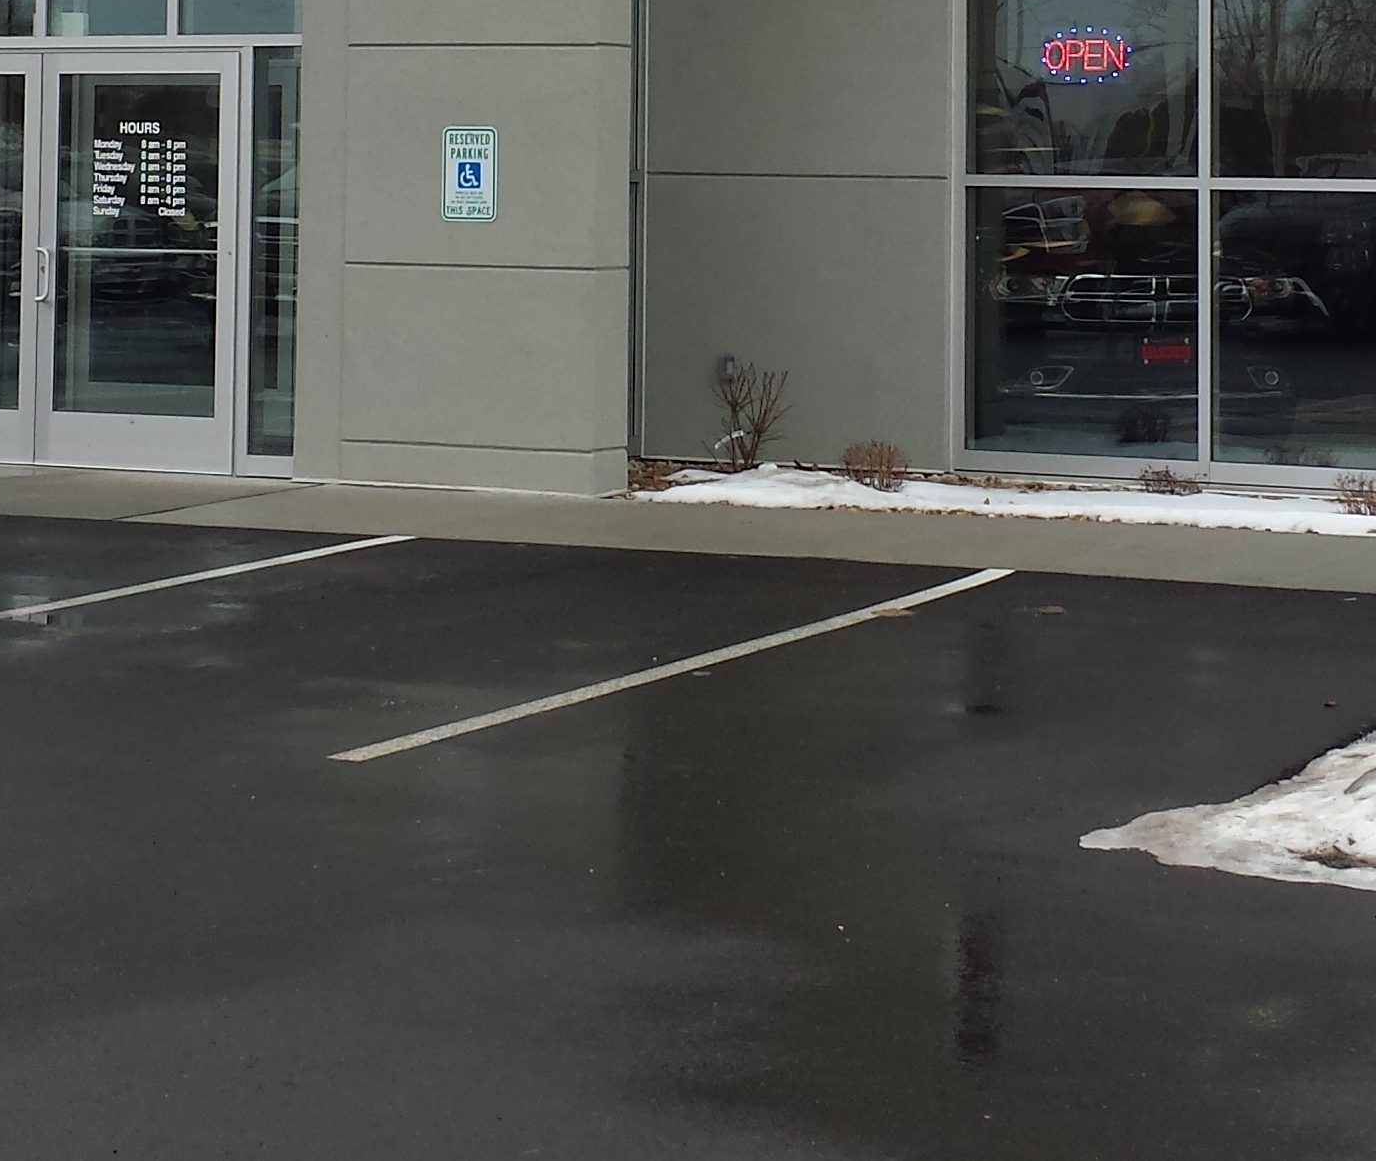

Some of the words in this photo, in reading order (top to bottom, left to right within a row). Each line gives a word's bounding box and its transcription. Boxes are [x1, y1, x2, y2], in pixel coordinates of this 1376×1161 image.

[1045, 39, 1124, 71] OPEN
[119, 122, 161, 134] HOURS
[94, 139, 122, 151] Monday
[174, 141, 186, 151] pm
[449, 134, 491, 145] RESERVED
[94, 150, 124, 161] Tuesday
[173, 152, 186, 161] pm
[451, 148, 489, 159] PARKING
[94, 162, 136, 173] Wednesday
[173, 163, 186, 173] pm
[94, 173, 128, 184] Thursday
[173, 175, 185, 185] pm
[93, 184, 116, 195] Friday
[172, 186, 185, 195] pm
[93, 195, 126, 206] Saturday
[165, 195, 171, 205] 4
[172, 197, 185, 207] pm
[93, 206, 120, 217] Sunday
[158, 206, 185, 216] Closed
[447, 206, 463, 215] THIS
[468, 206, 491, 215] SPACE
